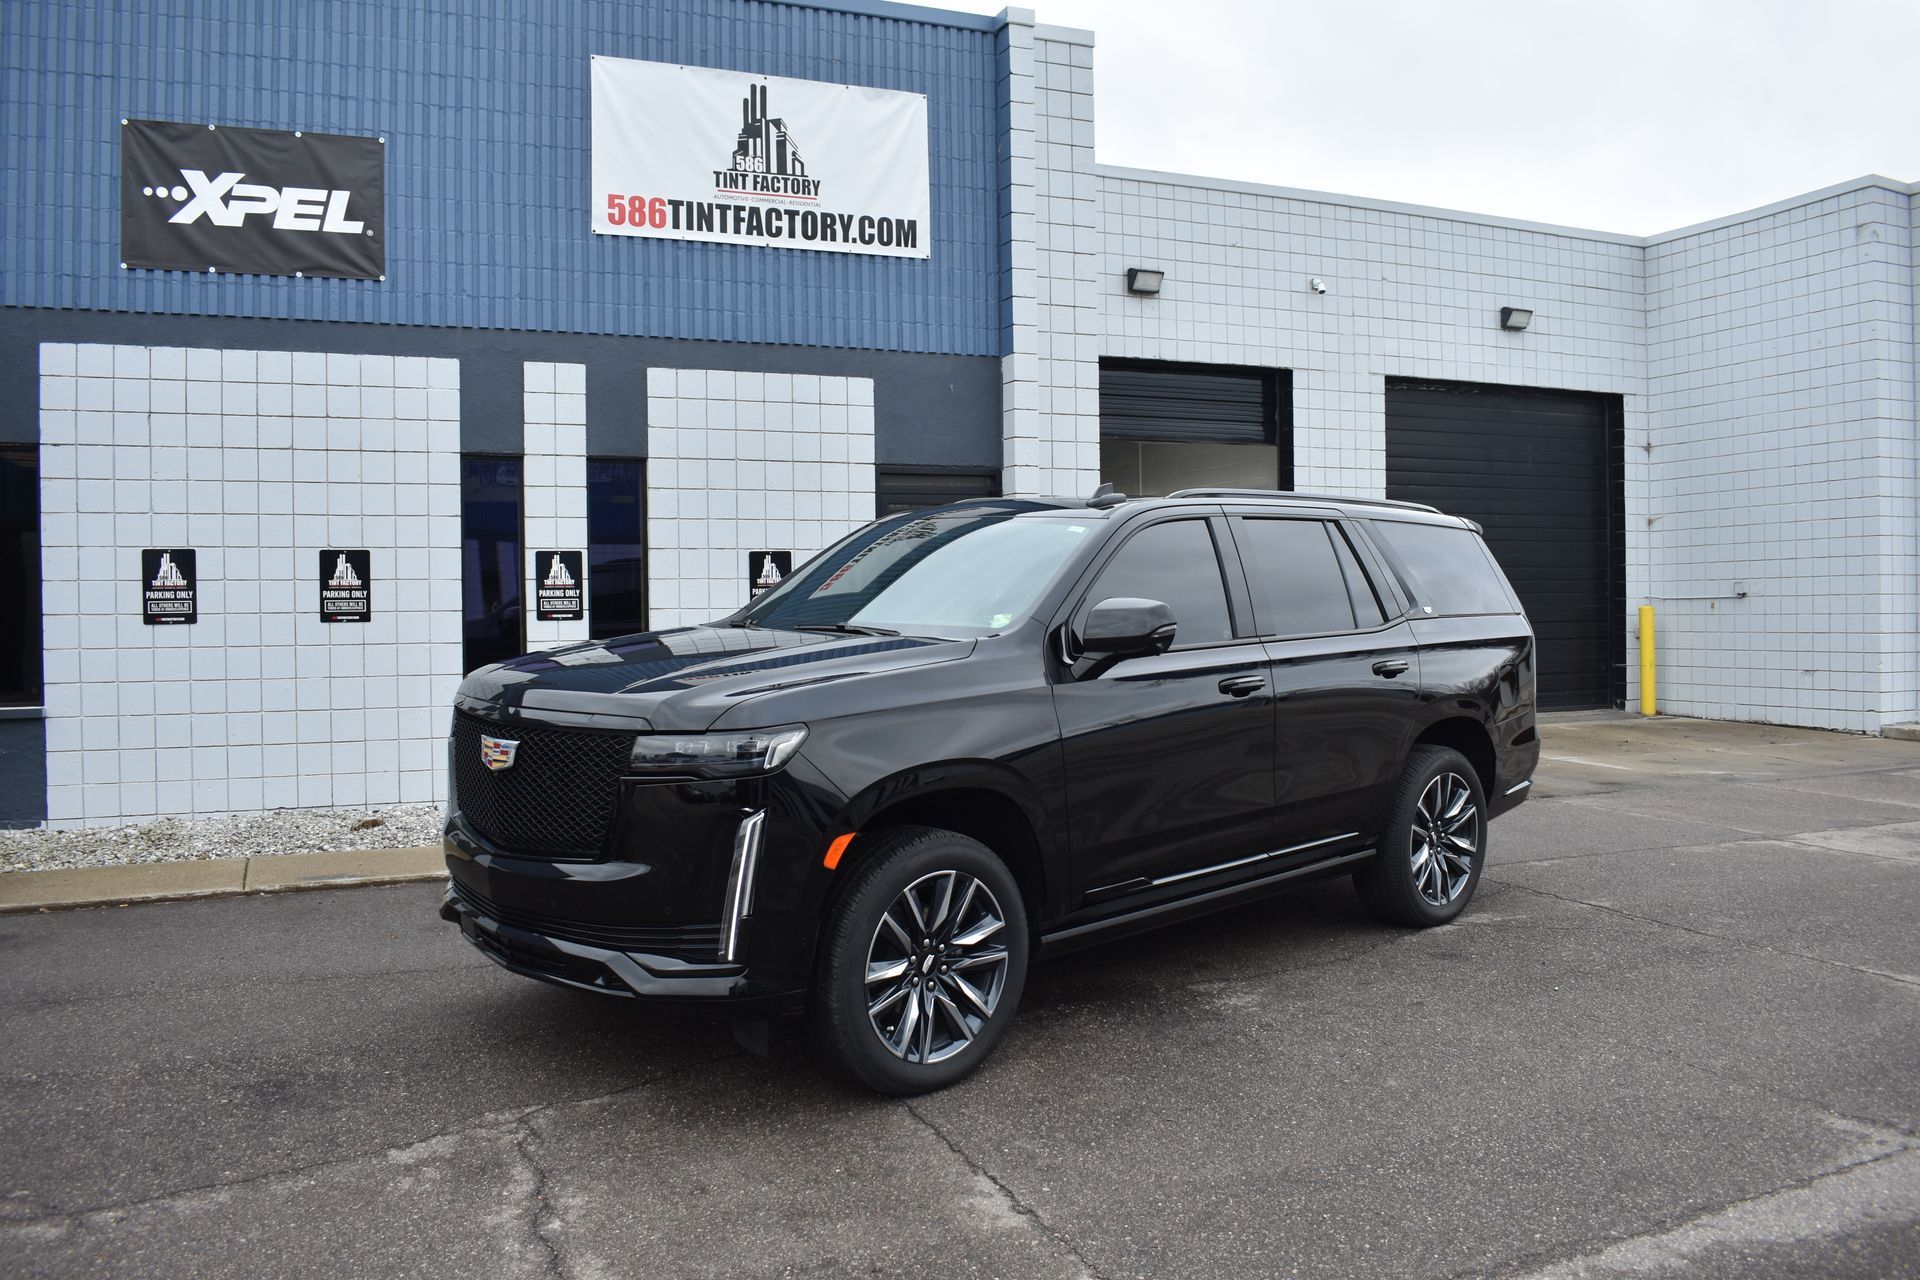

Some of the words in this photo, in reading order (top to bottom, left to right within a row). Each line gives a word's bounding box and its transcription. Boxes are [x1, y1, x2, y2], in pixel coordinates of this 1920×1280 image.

[735, 155, 763, 173] 586
[713, 171, 748, 191] TINT
[753, 174, 821, 196] FACTORY
[168, 169, 364, 234] XPEL
[713, 193, 749, 201] AUTOMOTIVE
[607, 193, 917, 249] 586TINTFACTORY.COM
[146, 591, 174, 599] PARKING
[176, 590, 193, 598] ONLY
